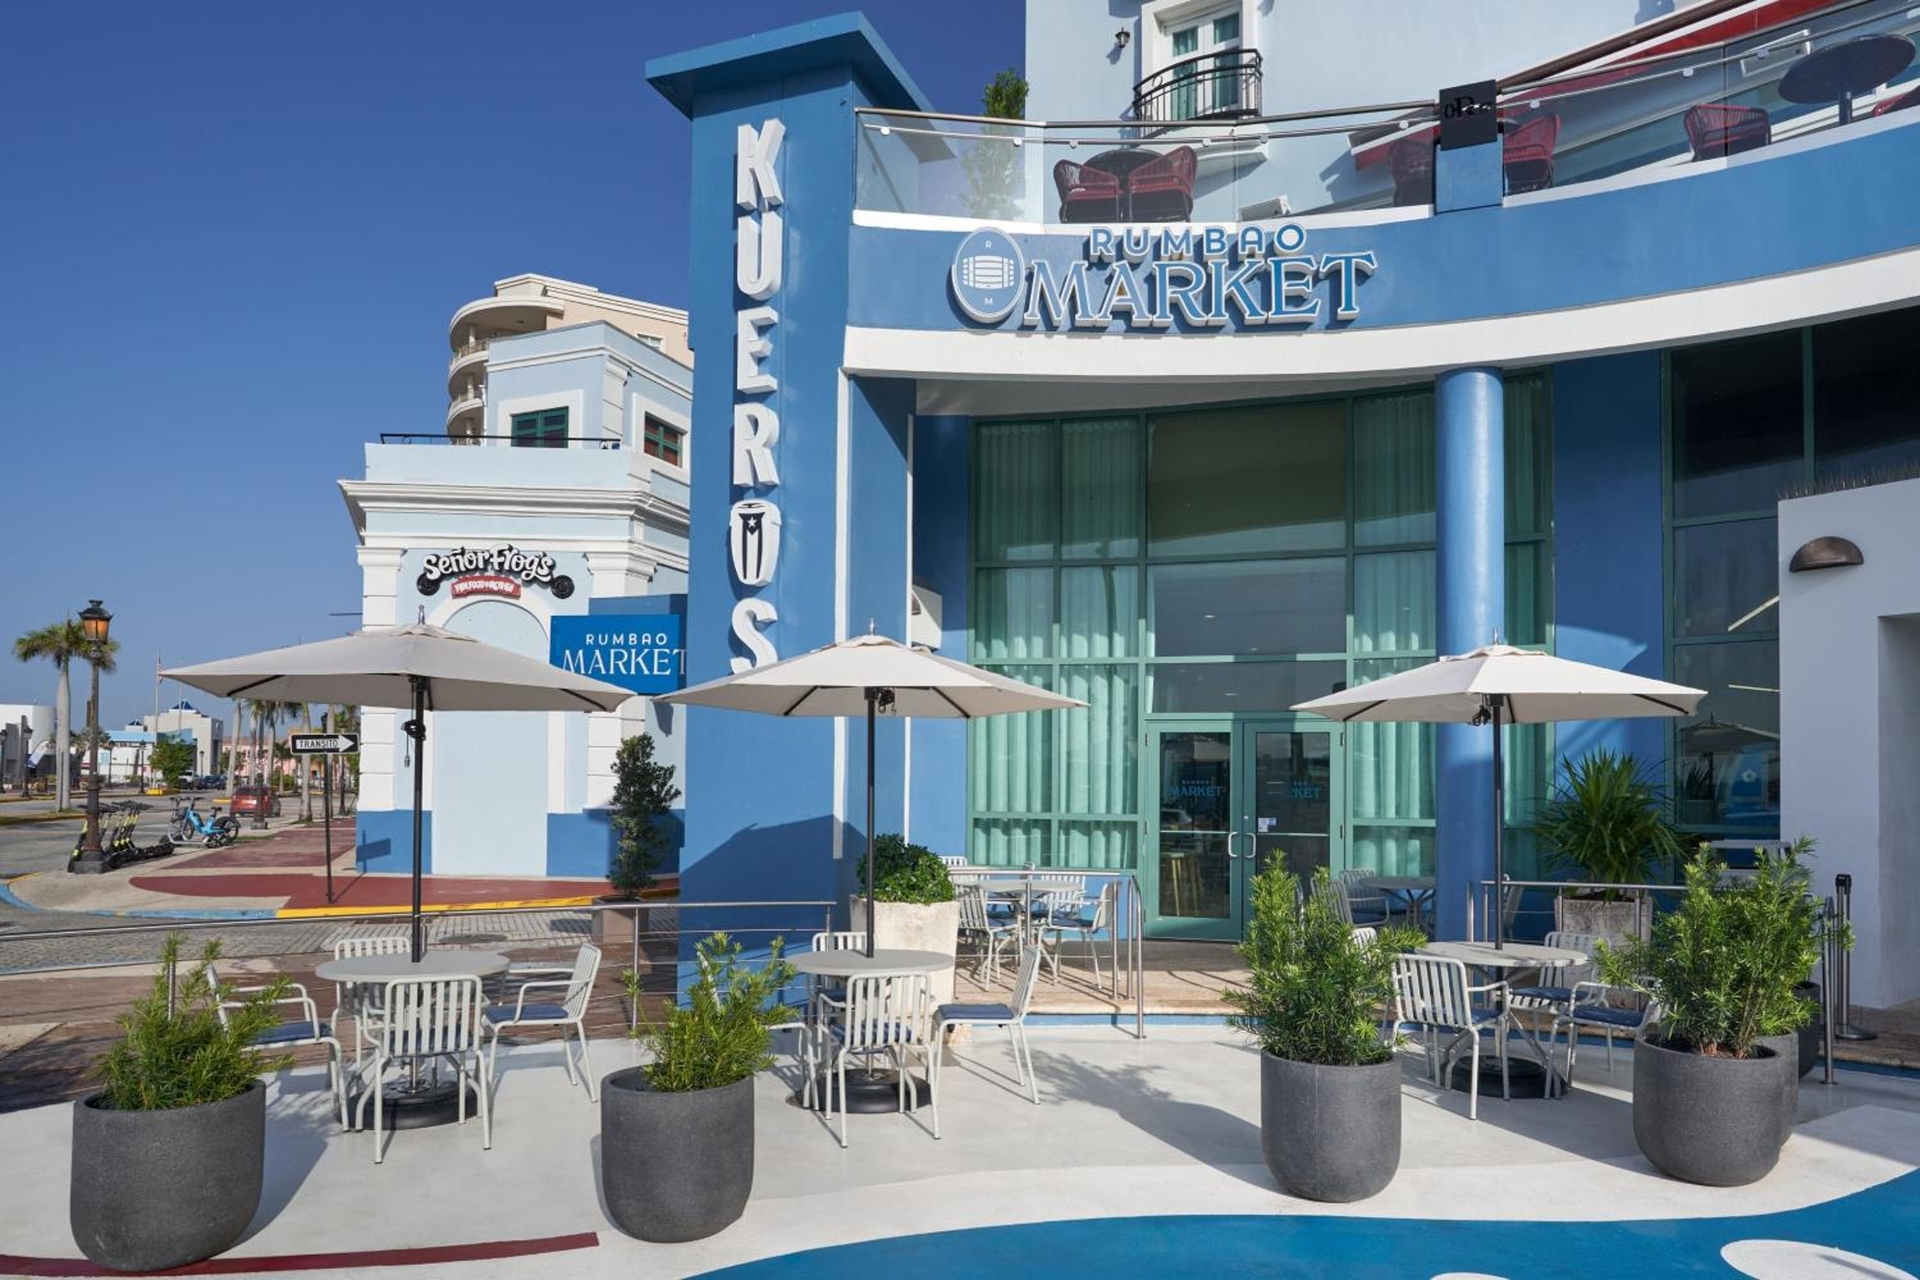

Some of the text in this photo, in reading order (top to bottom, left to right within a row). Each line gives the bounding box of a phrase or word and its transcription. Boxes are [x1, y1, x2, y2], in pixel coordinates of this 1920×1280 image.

[985, 240, 992, 249] R
[1089, 223, 1307, 260] RUMBAO
[1023, 250, 1379, 328] MARKET
[984, 297, 994, 305] M
[422, 545, 491, 581] Señor
[585, 632, 667, 646] RUMBAO
[562, 648, 687, 676] MARKET
[299, 739, 339, 748] TRANSITO
[1168, 785, 1223, 797] MARKET
